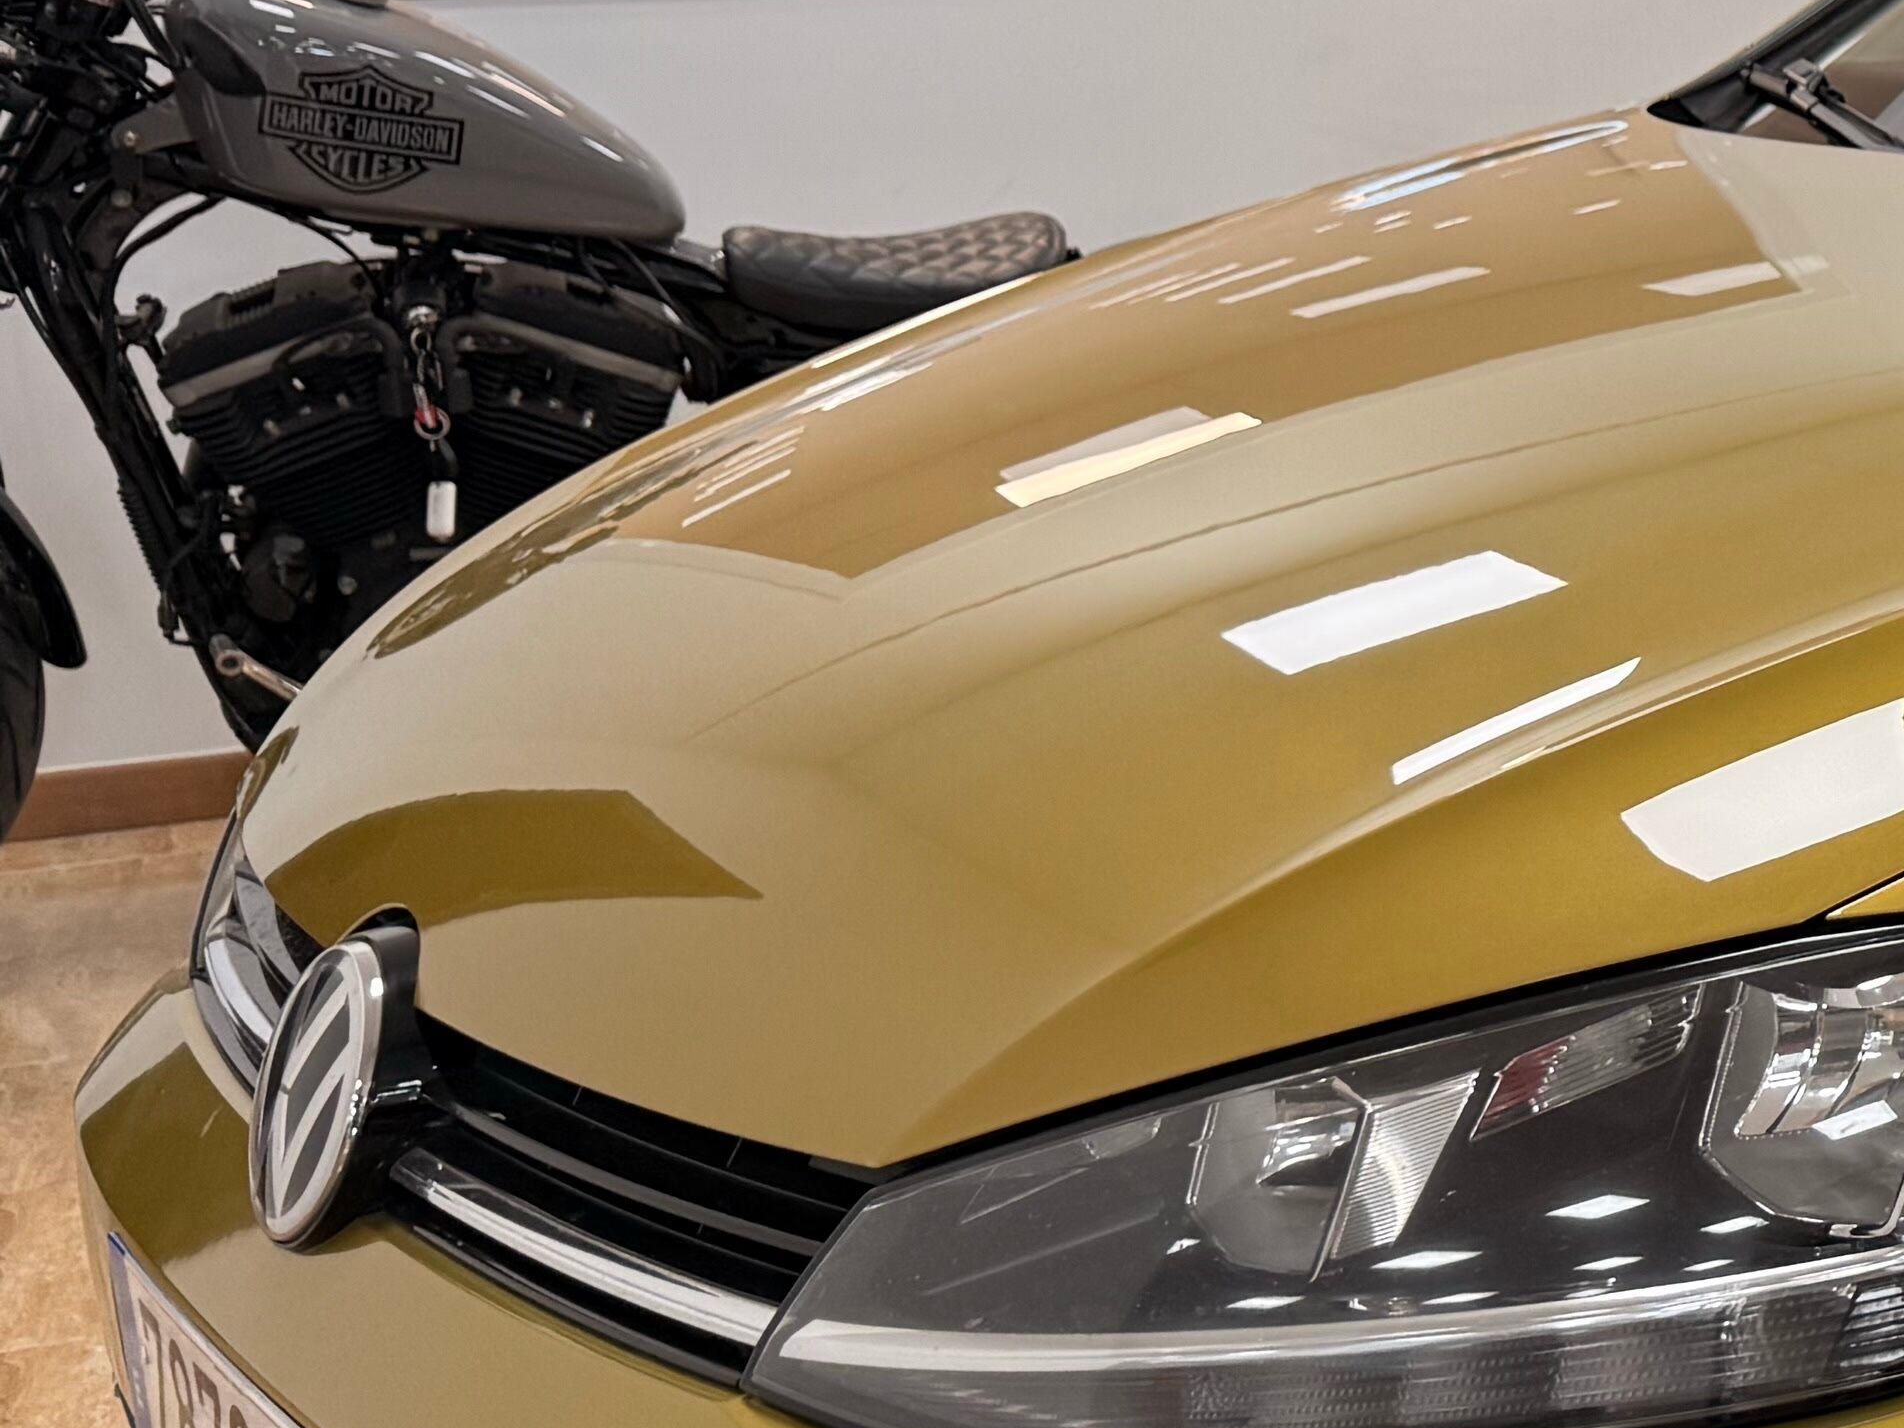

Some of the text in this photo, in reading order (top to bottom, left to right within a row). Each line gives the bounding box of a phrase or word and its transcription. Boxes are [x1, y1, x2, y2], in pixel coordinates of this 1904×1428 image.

[319, 78, 413, 115] MOTOR
[271, 102, 451, 154] HARLEY-DAVIDSON
[310, 142, 406, 183] CYCLES
